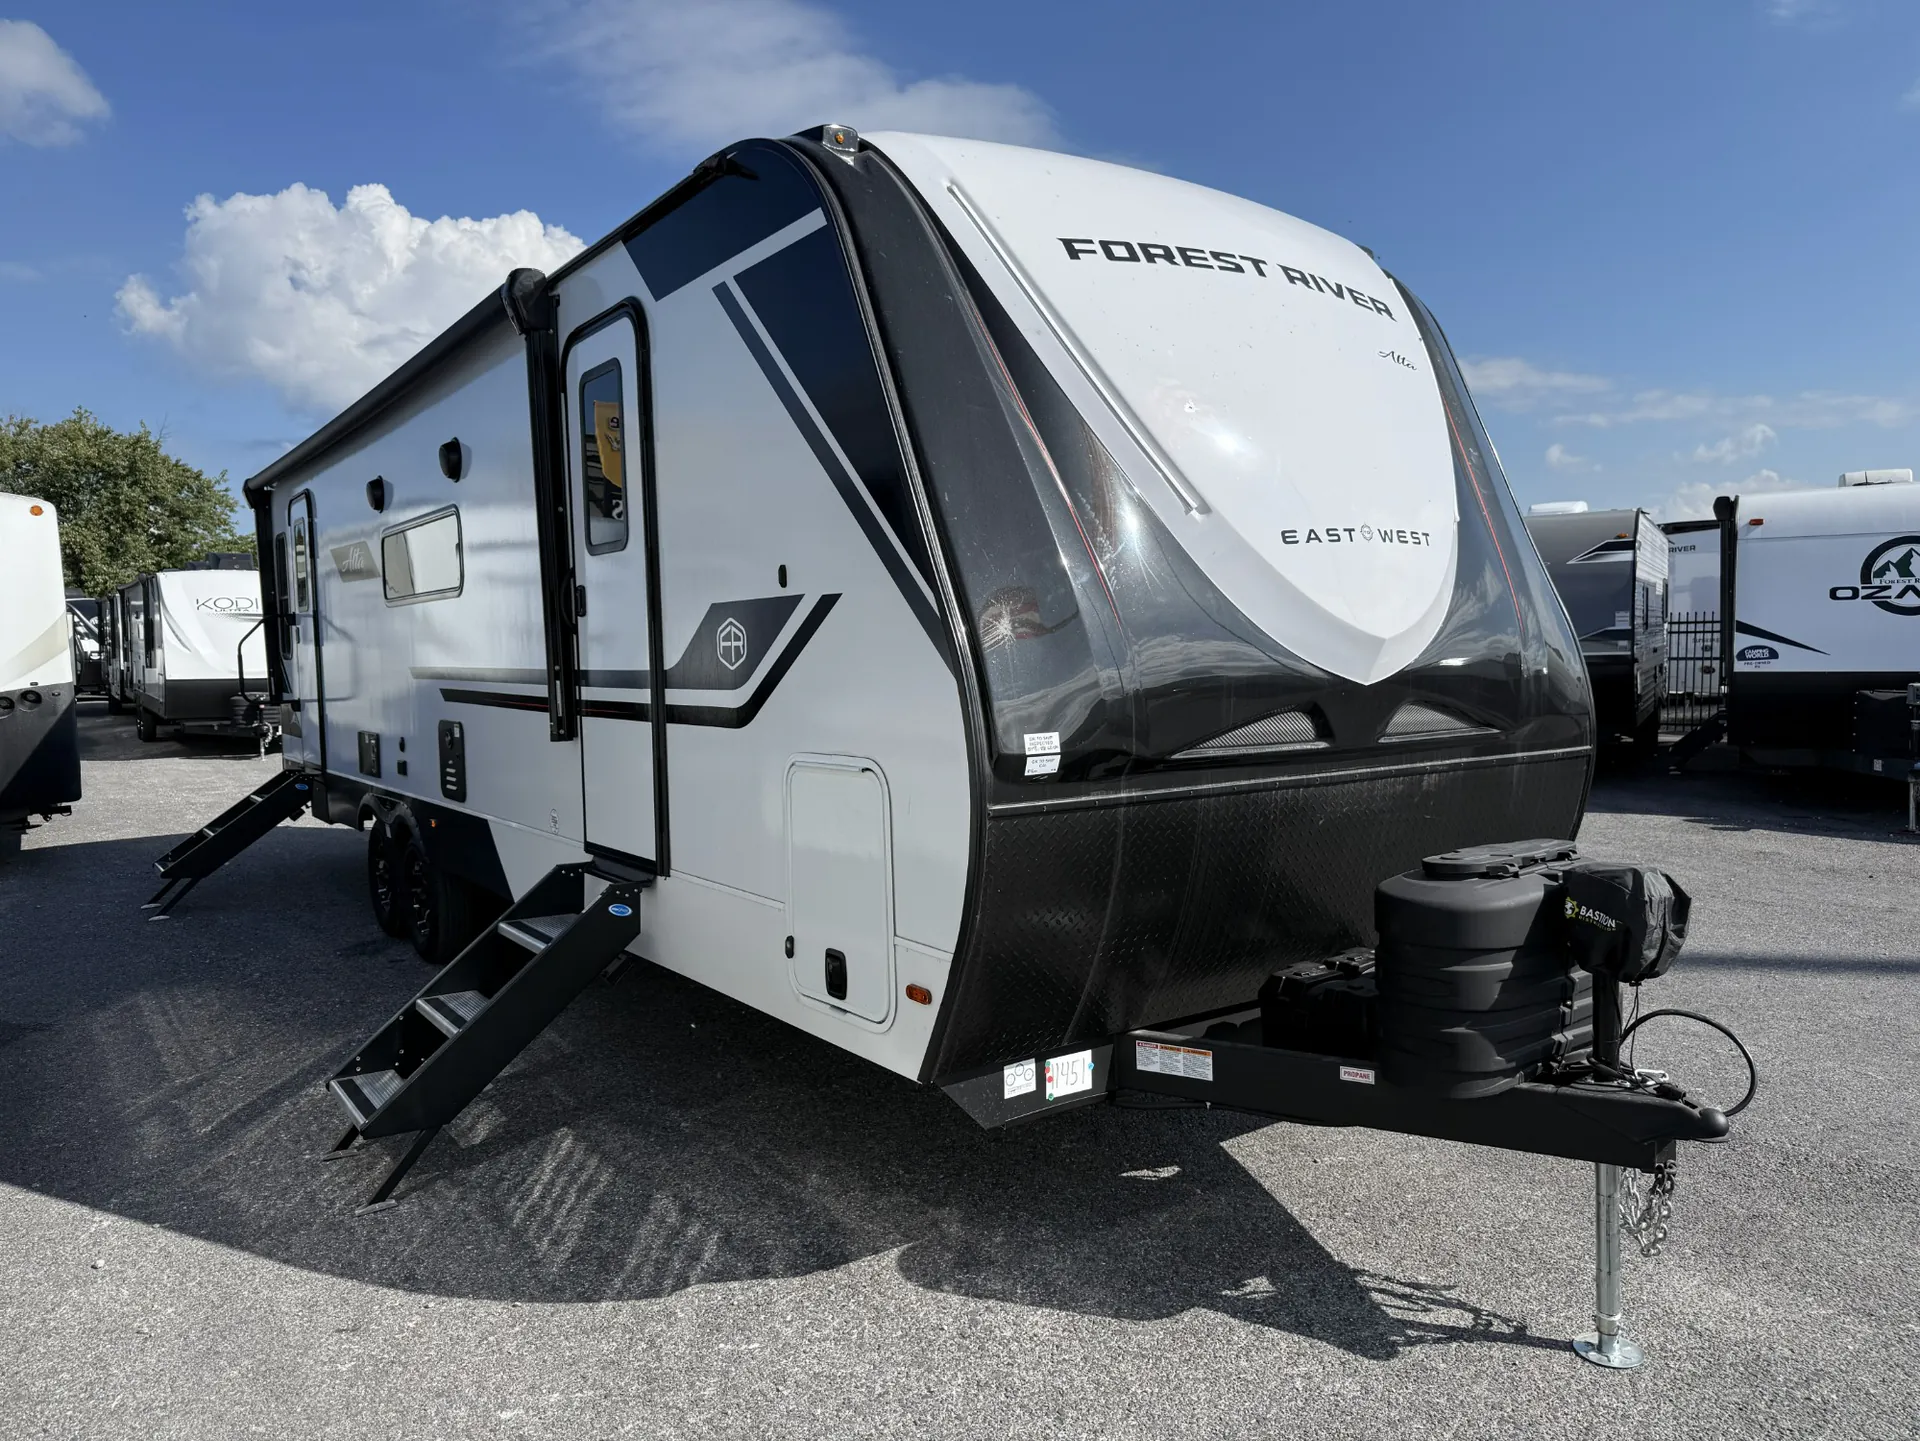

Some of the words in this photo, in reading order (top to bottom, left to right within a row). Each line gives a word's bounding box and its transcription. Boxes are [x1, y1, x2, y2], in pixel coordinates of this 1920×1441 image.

[1056, 237, 1268, 278] FOREST
[1276, 263, 1397, 323] RIVER
[1377, 350, 1418, 371] Alta
[1280, 527, 1356, 545] EAST
[1377, 528, 1430, 547] WEST
[1668, 544, 1696, 553] RIVER
[1580, 905, 1616, 928] BASTION
[1343, 1070, 1371, 1080] PROPANE
